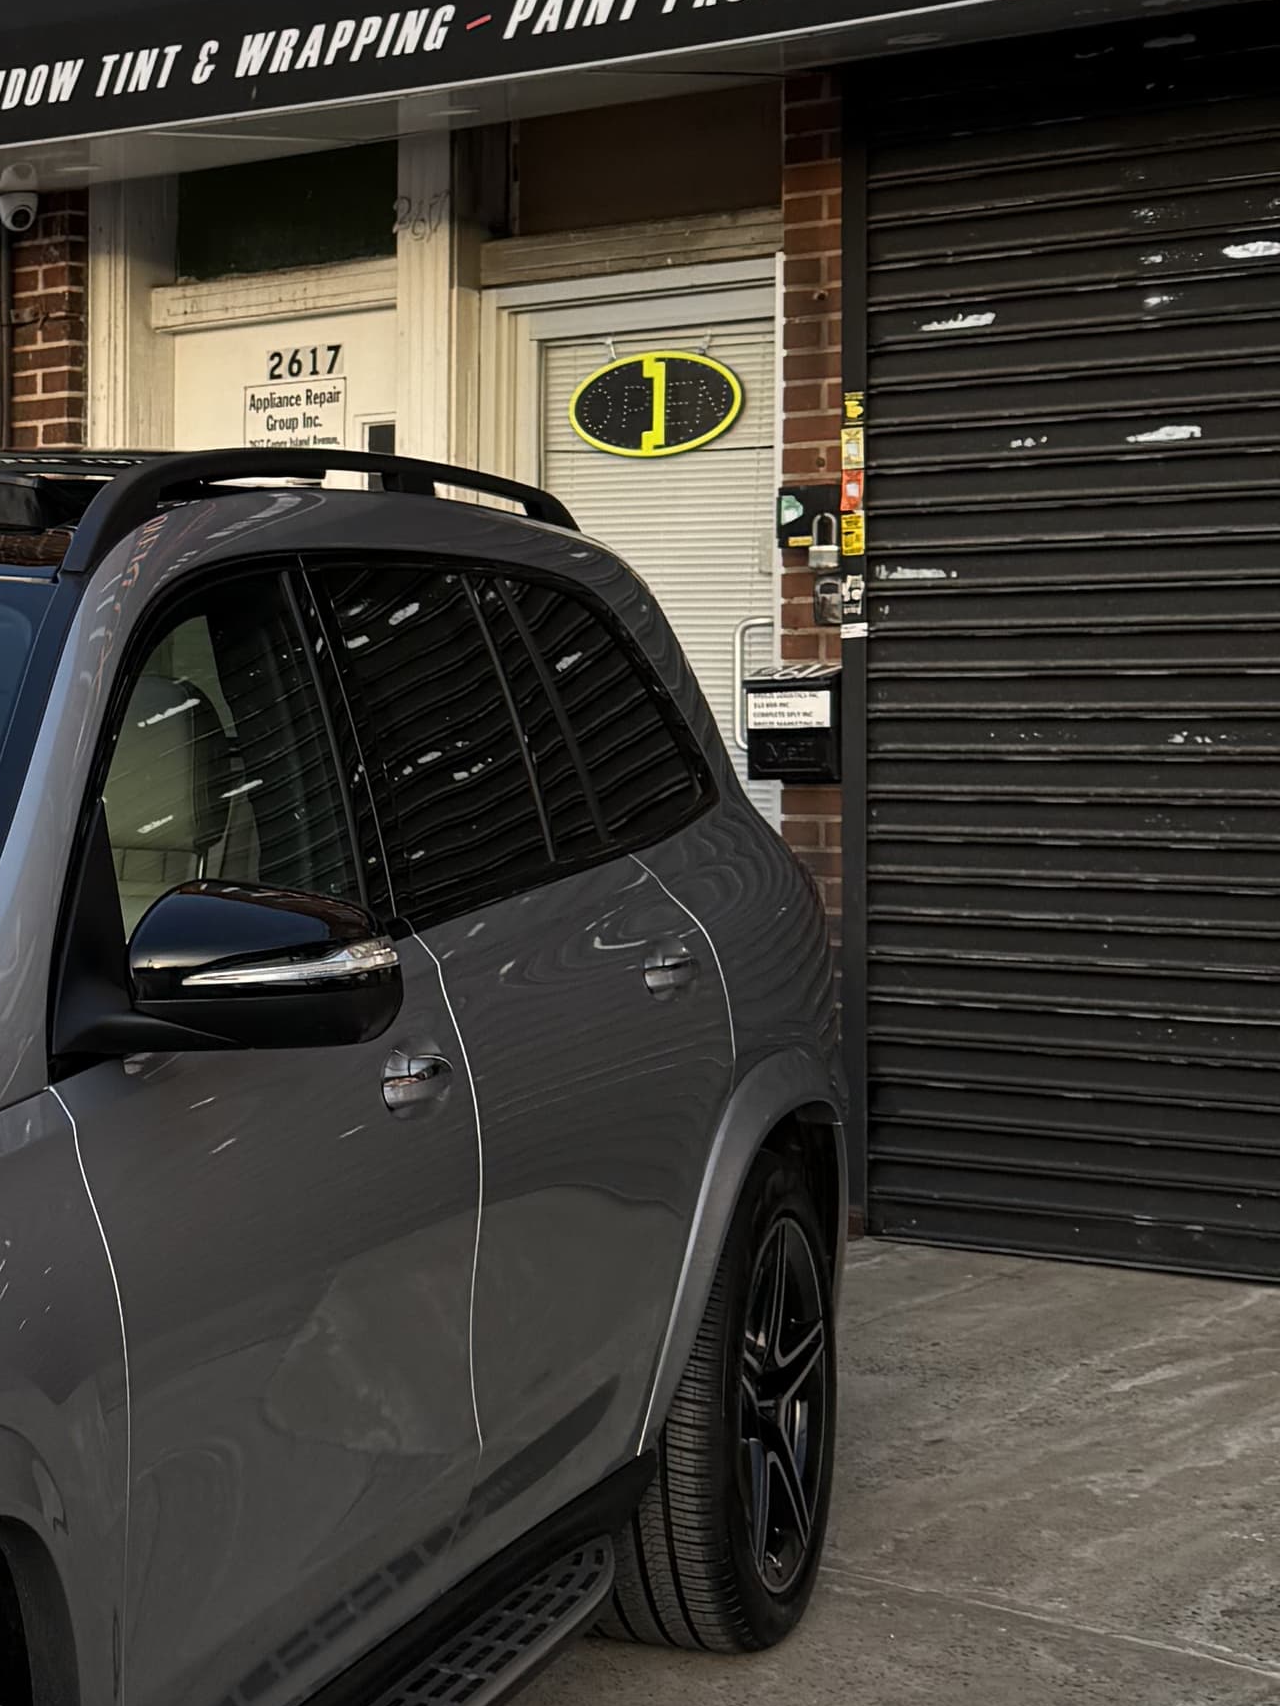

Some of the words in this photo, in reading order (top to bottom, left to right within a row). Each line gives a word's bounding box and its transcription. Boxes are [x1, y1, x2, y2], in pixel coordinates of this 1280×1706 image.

[93, 43, 179, 101] TINT
[191, 37, 217, 85] &
[232, 2, 457, 79] WRAPPING
[268, 344, 342, 381] 2617
[248, 391, 302, 414] Appliance
[305, 386, 342, 408] Repair
[583, 379, 729, 432] OPEN
[266, 414, 299, 432] Group
[302, 412, 324, 429] Inc.
